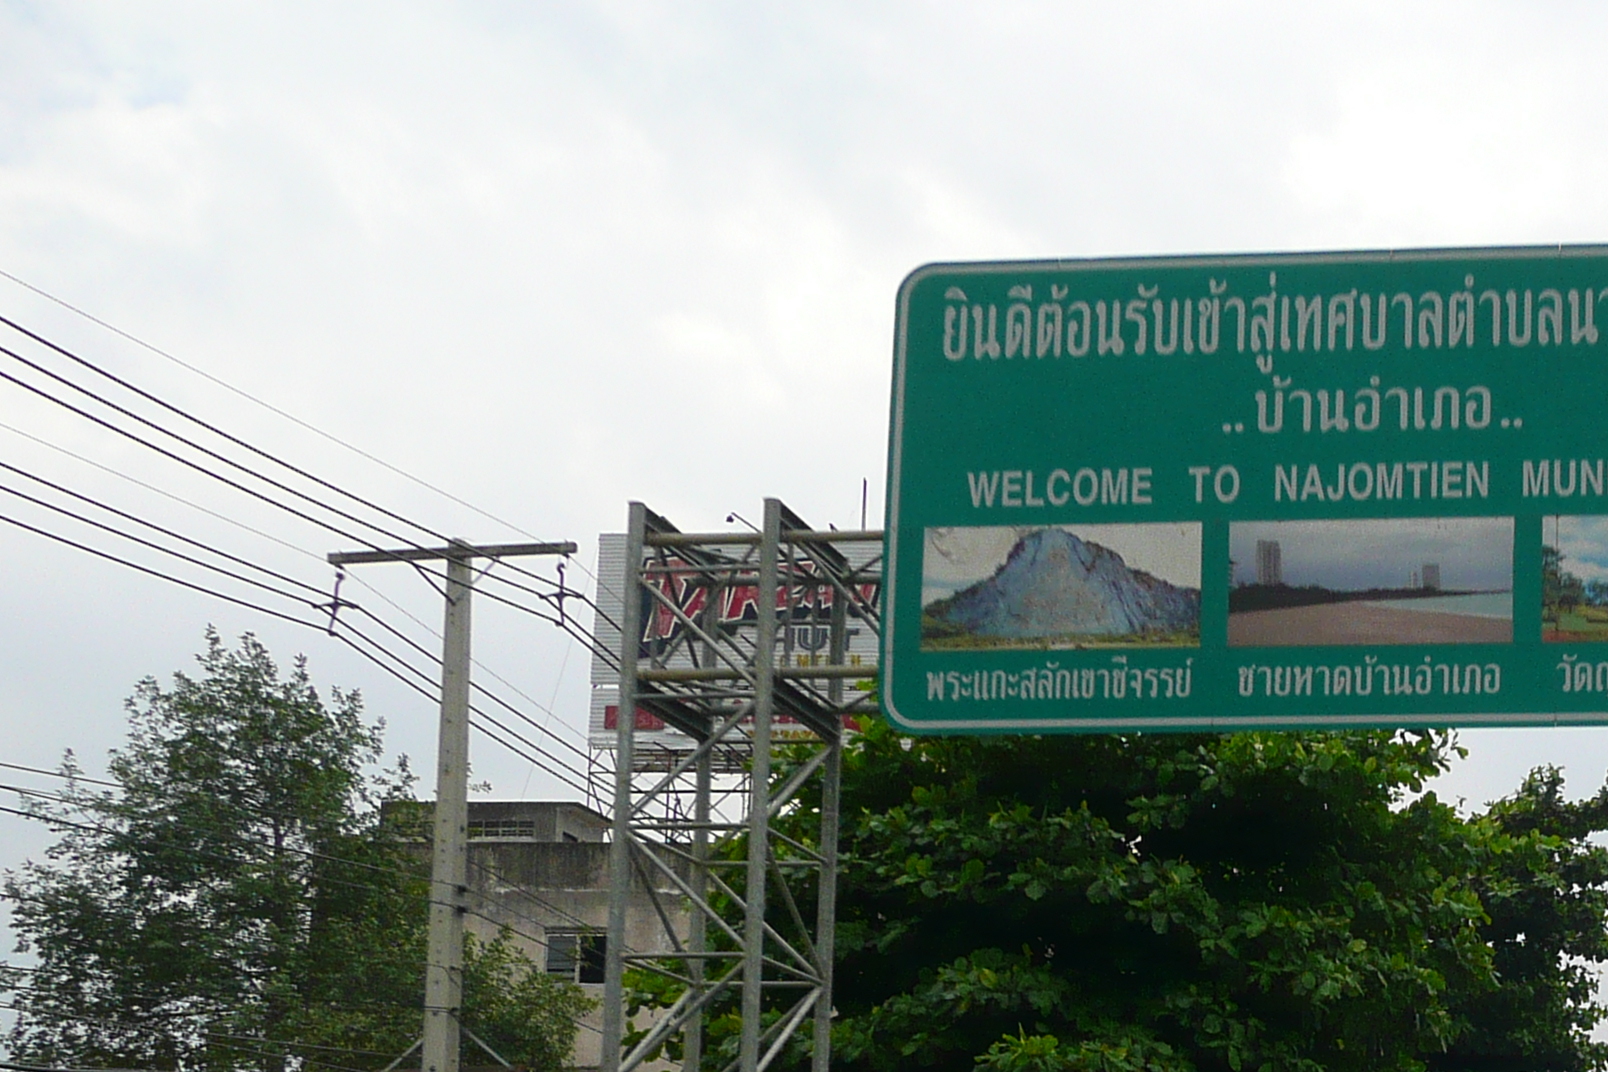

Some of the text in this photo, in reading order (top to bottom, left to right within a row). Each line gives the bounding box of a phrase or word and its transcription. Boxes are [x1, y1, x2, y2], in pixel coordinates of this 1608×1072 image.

[967, 466, 1153, 508] WELCOME
[1188, 464, 1241, 503] TO
[1274, 461, 1490, 503] NAJOMTIEN
[926, 656, 1194, 701] พระแกะสลักเขาชีจรรย์
[1238, 655, 1501, 697] ชายหาดบ้านอำเภอ
